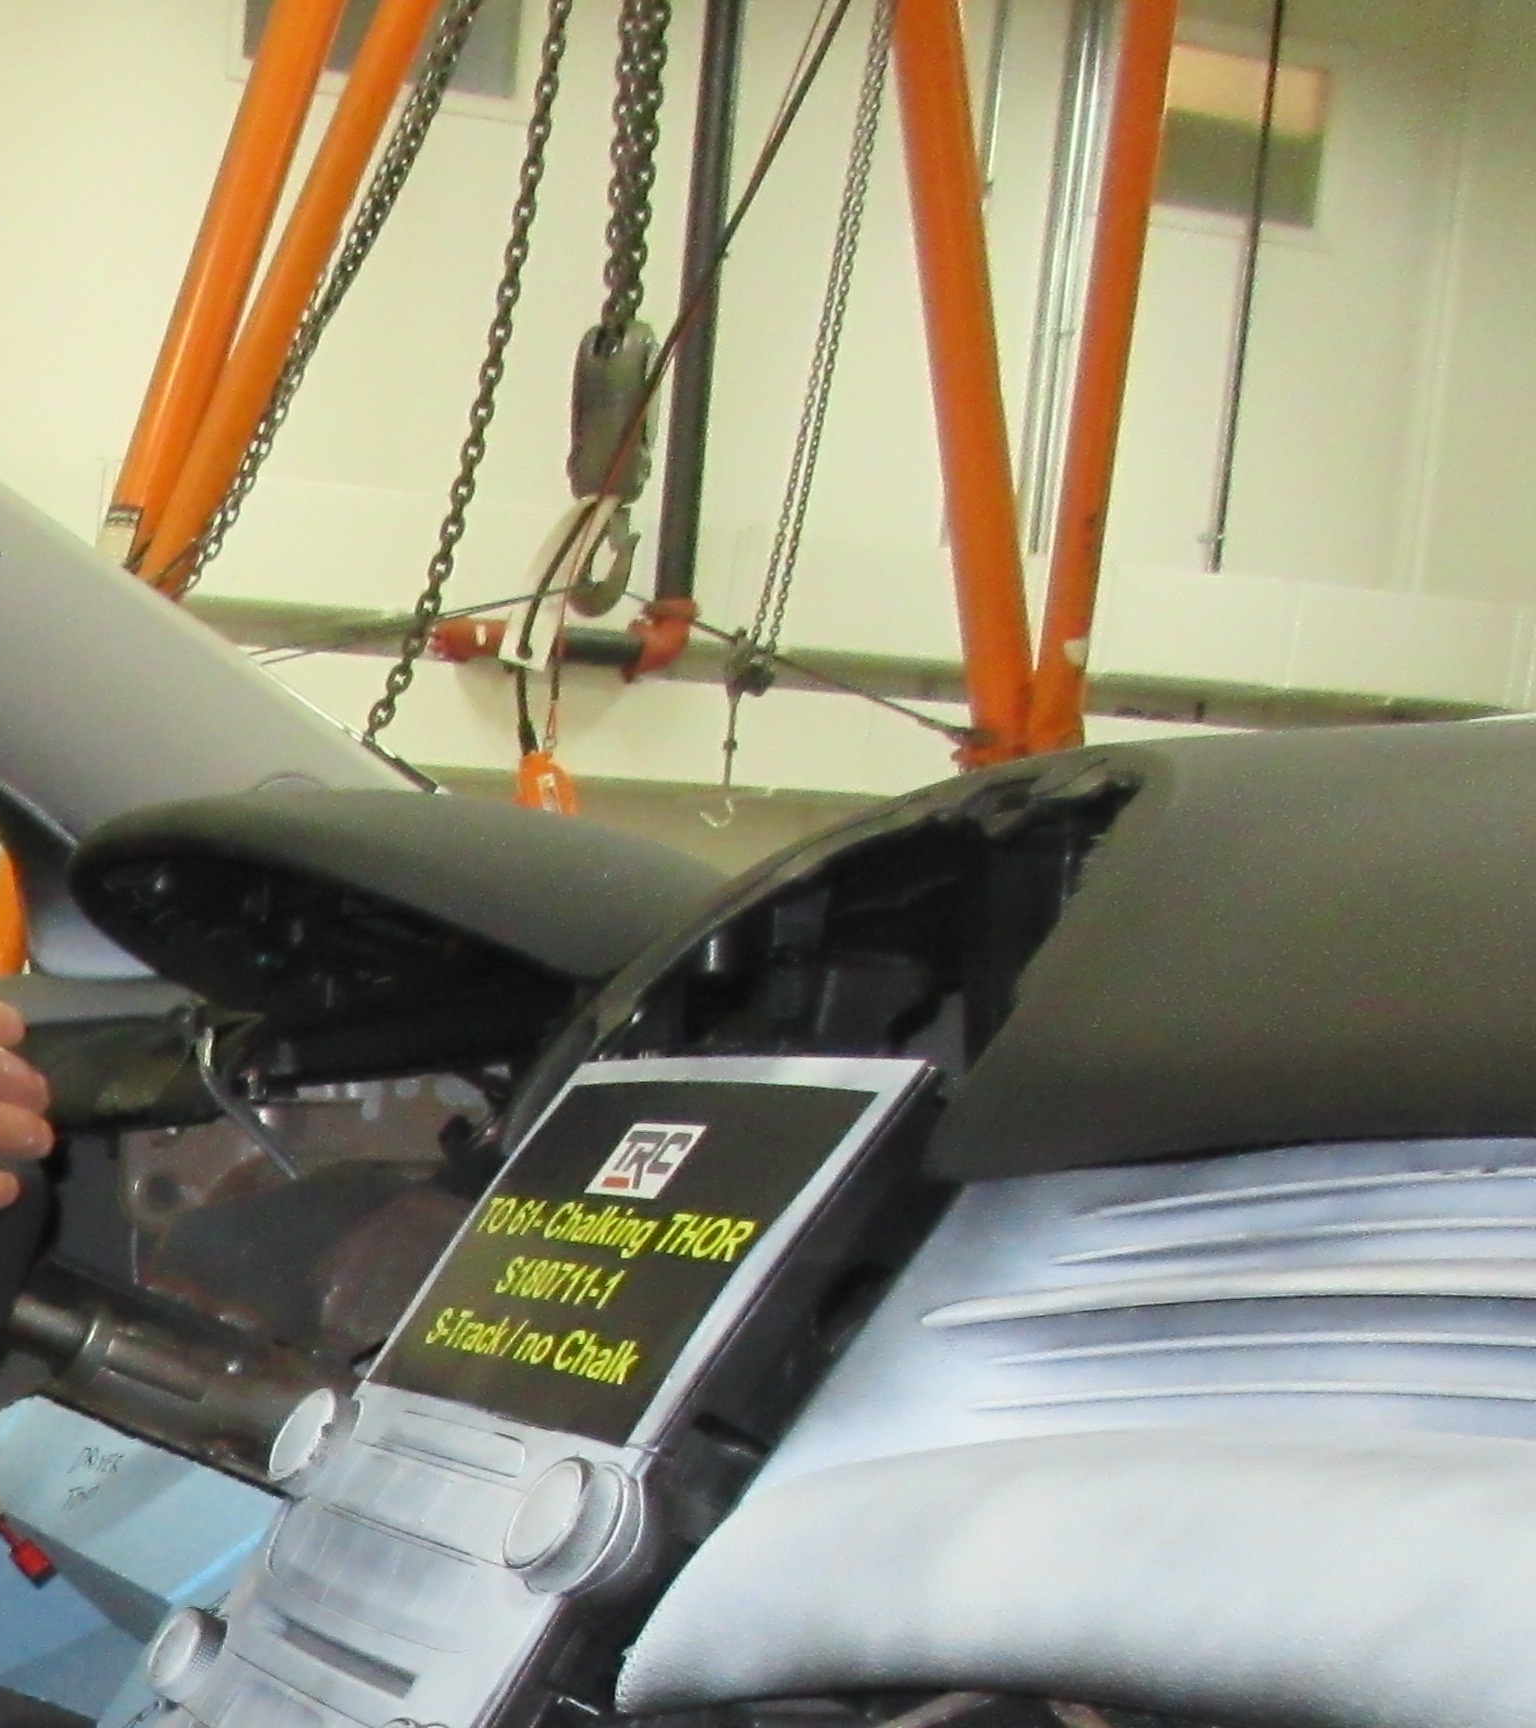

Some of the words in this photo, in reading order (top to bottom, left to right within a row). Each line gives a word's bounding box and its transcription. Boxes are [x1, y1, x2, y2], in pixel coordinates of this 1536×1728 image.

[613, 1130, 694, 1190] TRC
[478, 1197, 517, 1234] TO
[543, 1202, 658, 1259] Chalking
[654, 1213, 757, 1262] THOR
[495, 1256, 626, 1310] S180711-1
[425, 1306, 510, 1356] S-Track
[513, 1332, 554, 1364] no
[553, 1329, 639, 1385] Chalk
